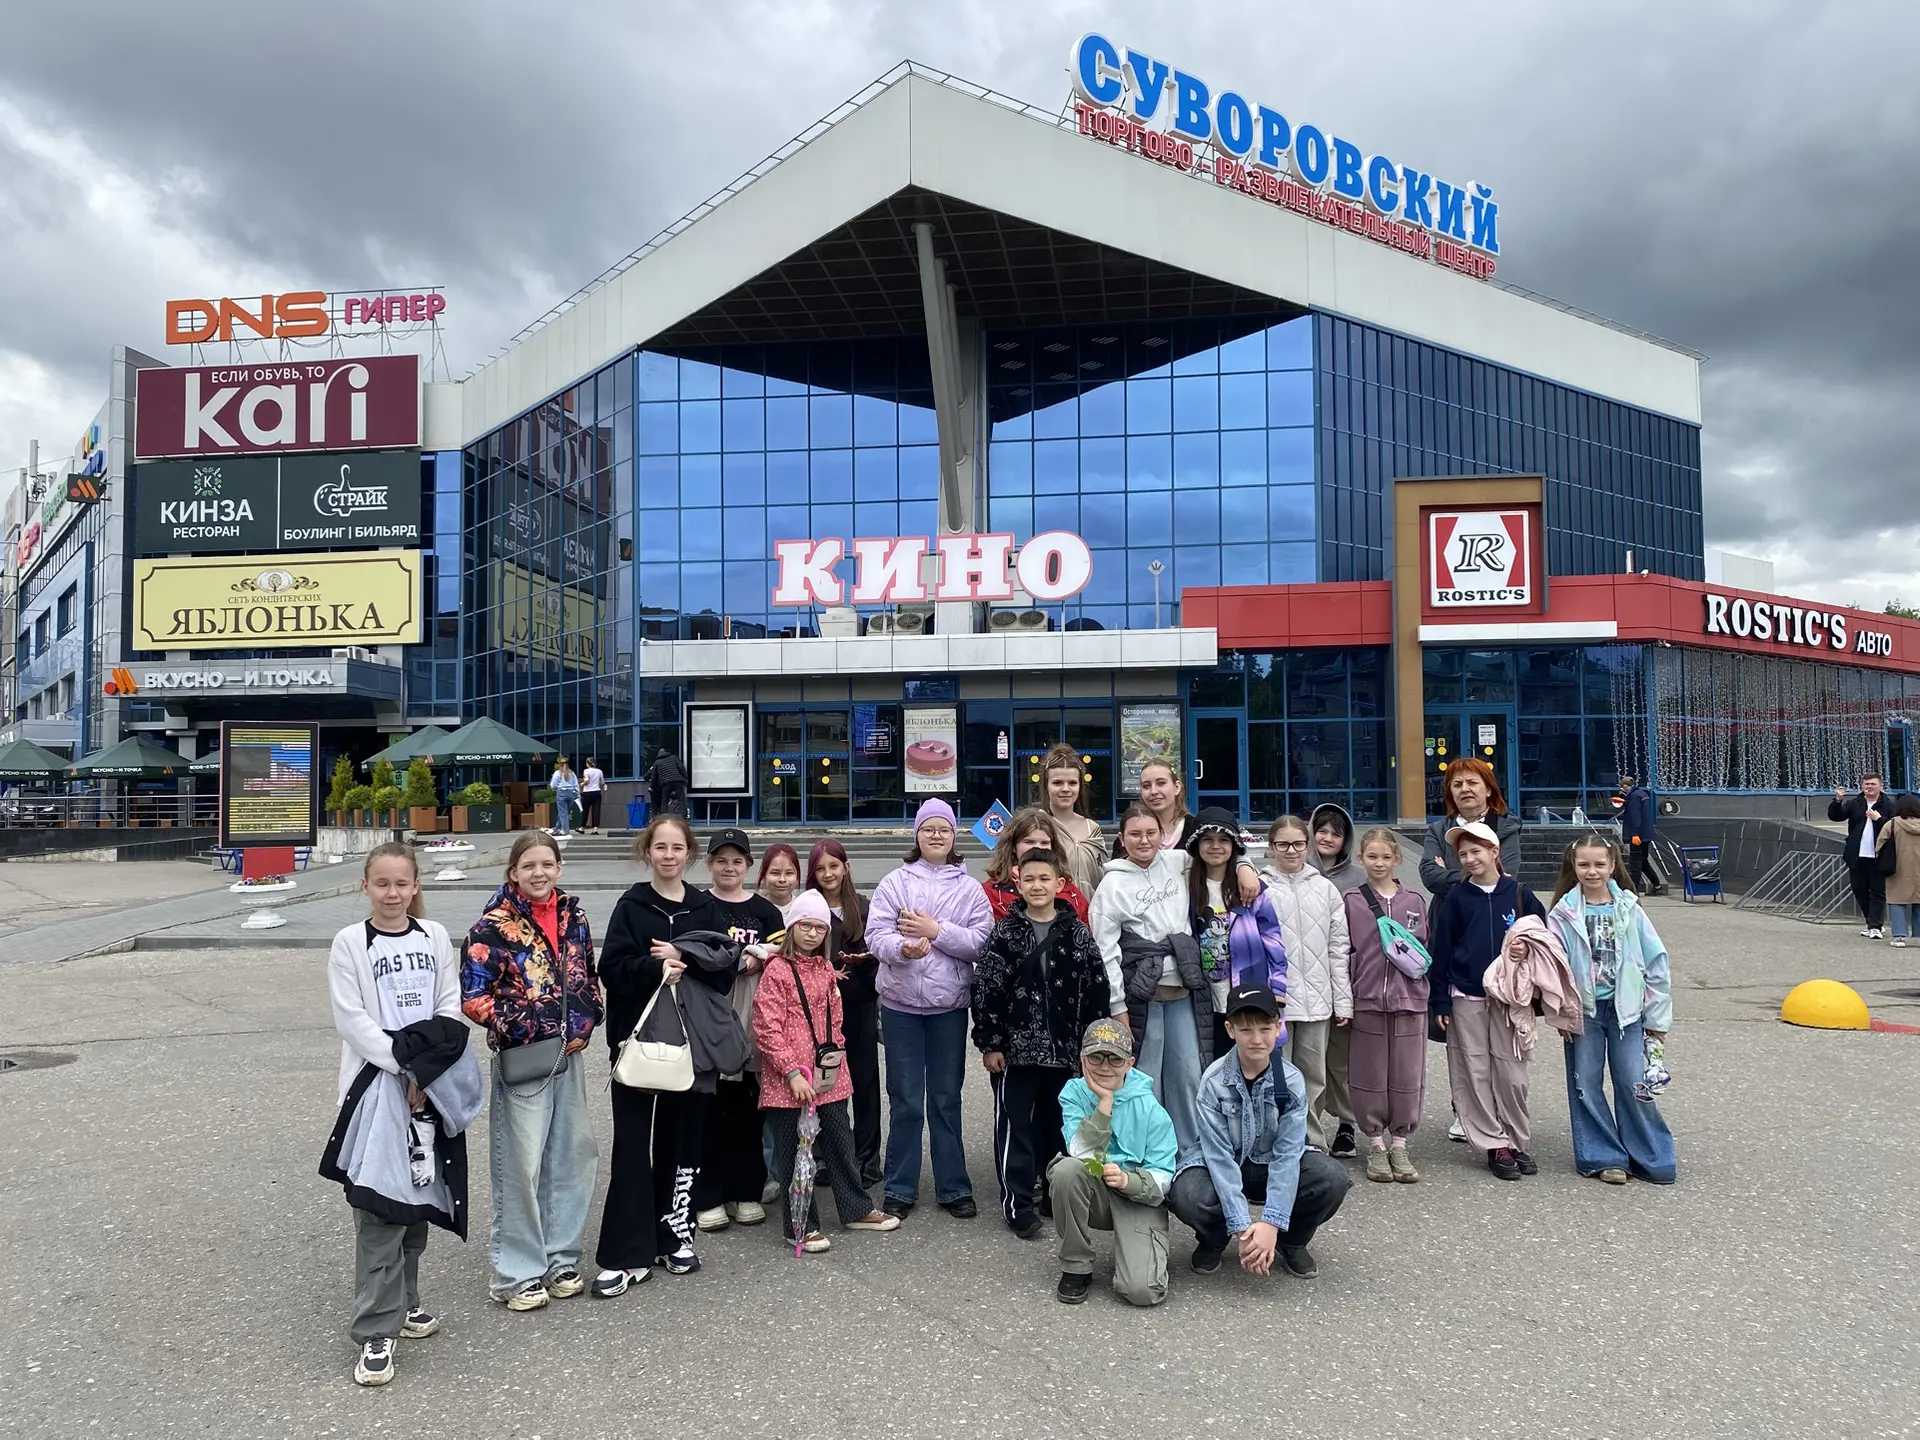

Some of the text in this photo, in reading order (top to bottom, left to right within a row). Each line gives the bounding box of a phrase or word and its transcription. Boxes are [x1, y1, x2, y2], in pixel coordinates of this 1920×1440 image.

[1070, 31, 1500, 257] СУВОРОВСКИЙ
[1075, 103, 1193, 172] ТОРГОВО
[1216, 156, 1431, 260] РАЗВЛЕКАТЕЛЬНЫЙ
[1436, 241, 1496, 281] ЦЕНТР
[166, 291, 446, 345] DNS ГИПЕР
[211, 366, 325, 383] ЕСЛИ ОБУВЬ, ТО
[184, 363, 370, 448] kari
[328, 490, 388, 507] СТРАЙК
[160, 499, 254, 524] КИНЗА
[173, 525, 240, 539] РЕСТОРАН
[284, 524, 417, 540] БОУЛИНГ БИЛЬЯРД
[1454, 533, 1505, 572] R
[772, 530, 1093, 607] КИНО
[228, 593, 322, 604] СЕТЬ КОНДИТЕРСКИХ
[1437, 589, 1525, 602] ROSTIC'S
[166, 601, 385, 636] ЯБЛОНЬКА
[1705, 593, 1892, 657] ROSTIC'S АВТО
[144, 671, 225, 689] ВКУСНО
[245, 670, 259, 686] И
[264, 669, 334, 687] ТОЧКА
[913, 783, 949, 791] 1 ЭТАЖ
